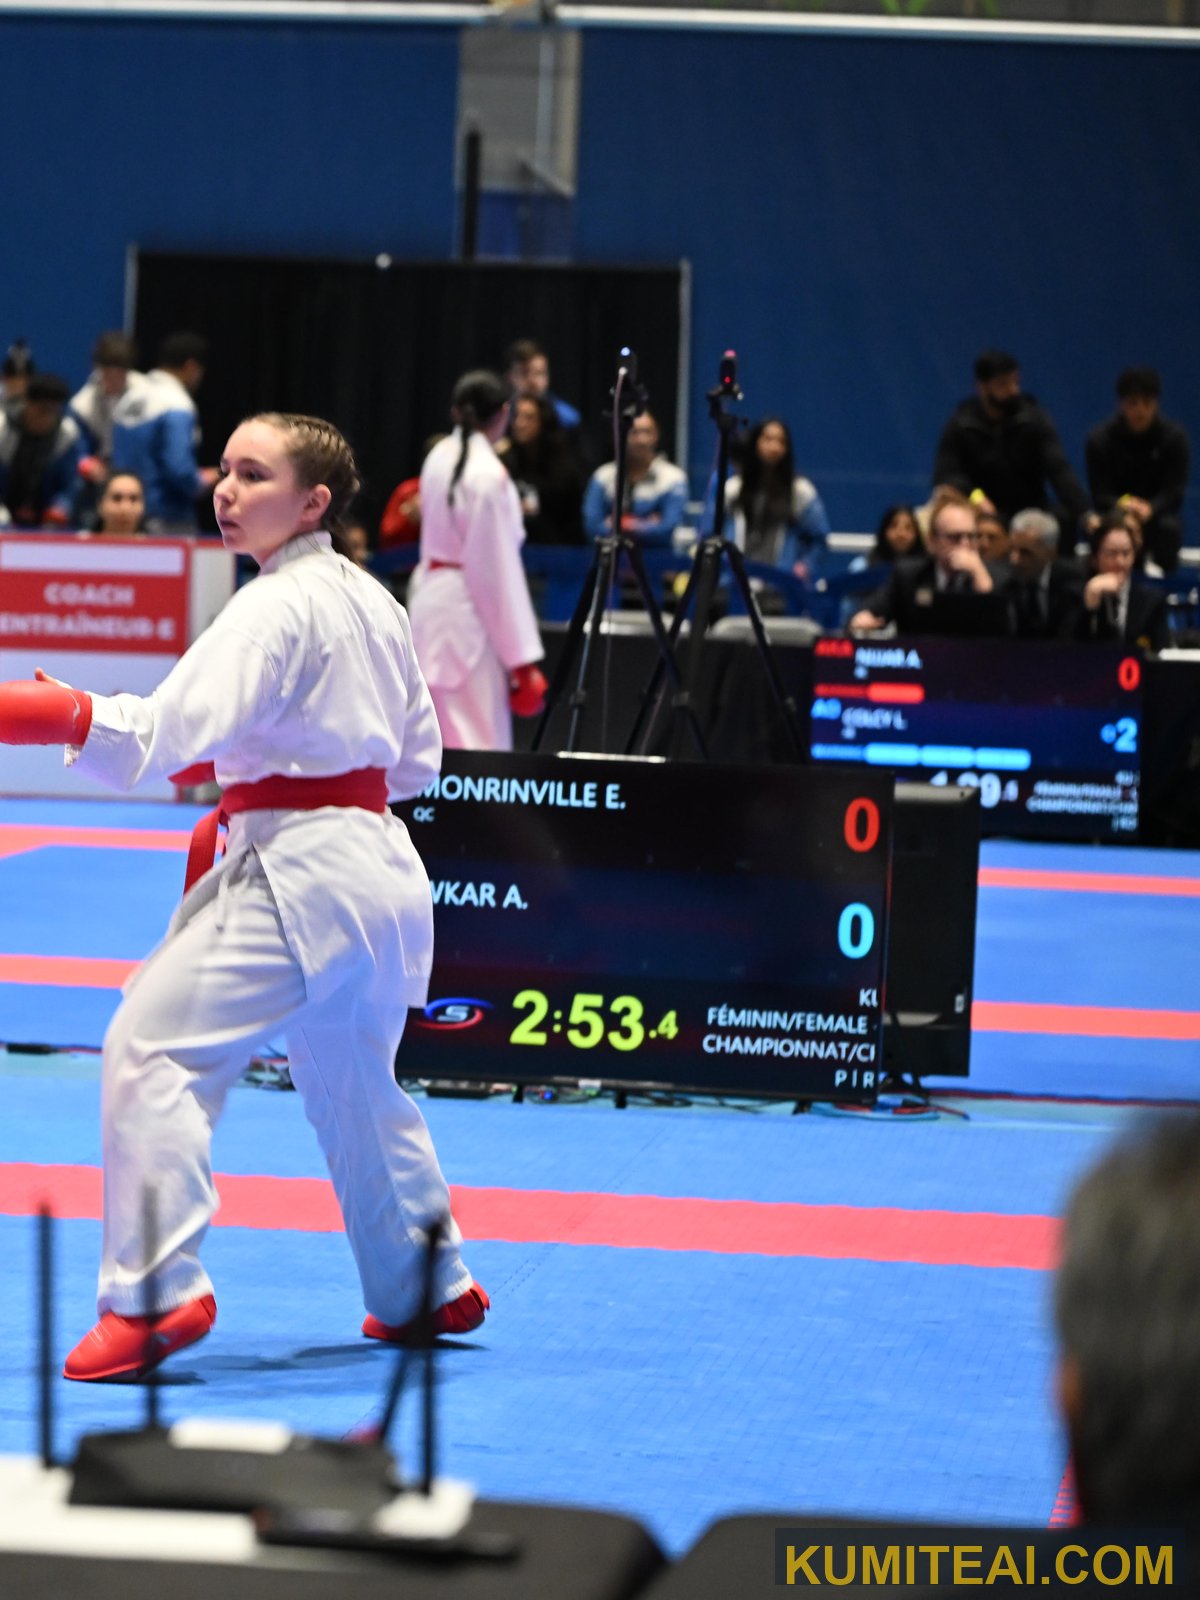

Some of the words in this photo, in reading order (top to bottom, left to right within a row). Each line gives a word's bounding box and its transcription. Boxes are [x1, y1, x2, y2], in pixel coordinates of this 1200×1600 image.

[44, 583, 135, 606] COACH
[1118, 657, 1140, 691] 0
[1114, 717, 1137, 752] 2
[605, 783, 626, 809] E.
[413, 806, 435, 822] QC
[844, 797, 880, 852] 0
[430, 880, 496, 908] VKAR
[502, 884, 529, 910] A.
[837, 902, 875, 959] 0
[509, 988, 680, 1051] 2:53.4
[707, 1003, 868, 1035] FÉMININ/FEMALE
